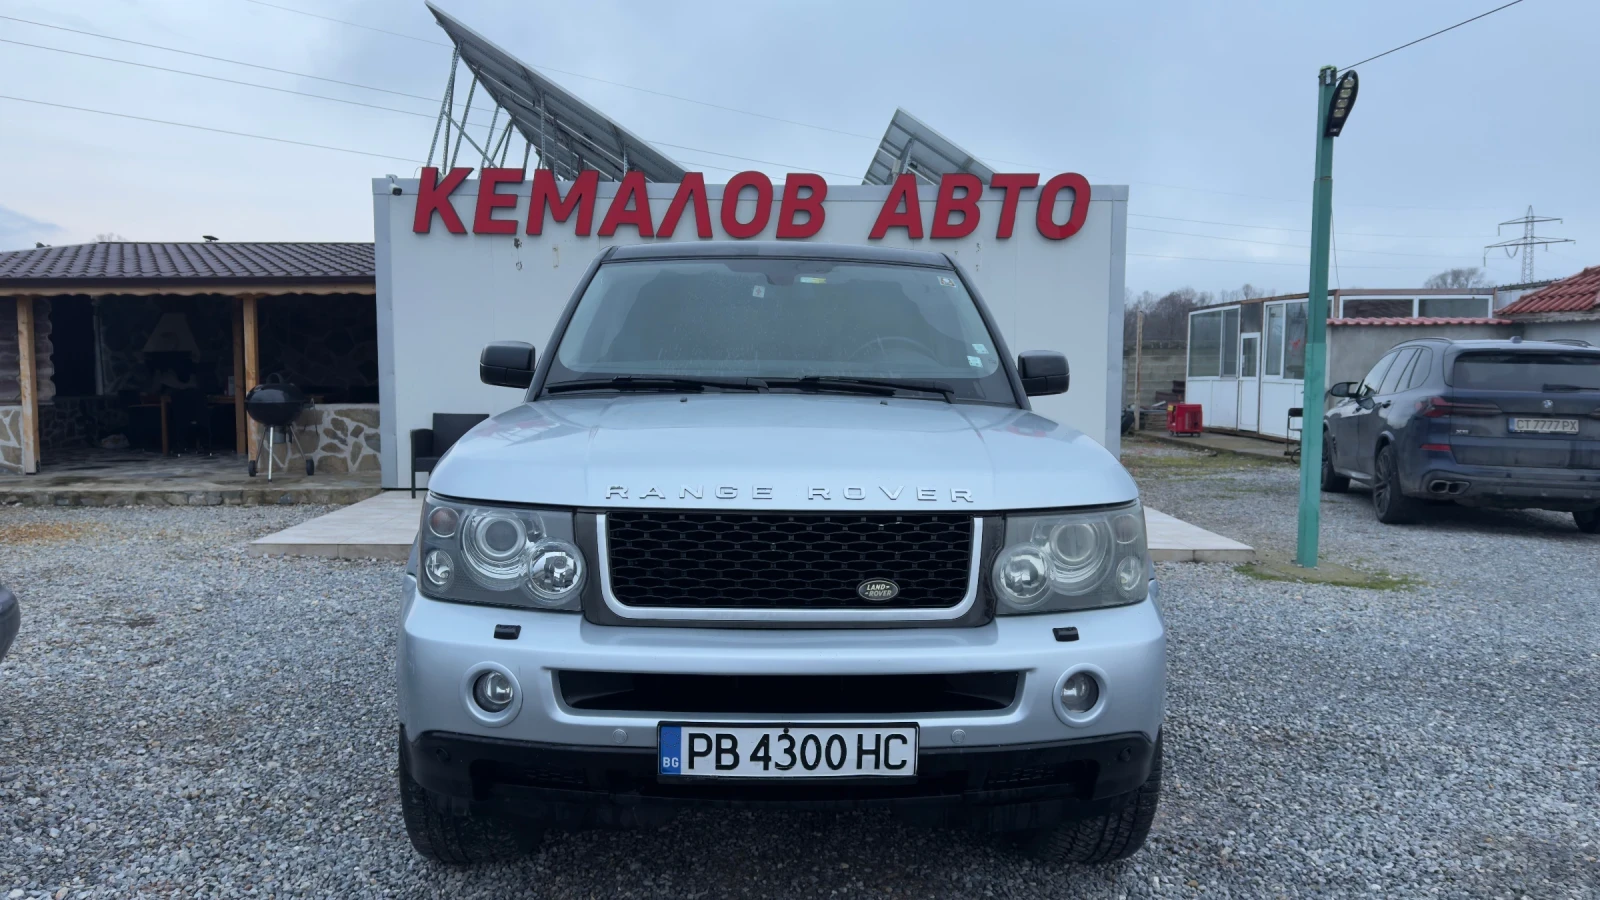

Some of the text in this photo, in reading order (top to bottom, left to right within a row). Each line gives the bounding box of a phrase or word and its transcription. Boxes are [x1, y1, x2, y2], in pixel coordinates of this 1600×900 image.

[413, 166, 1092, 240] КЕМАЛОВ АВТО
[1533, 420, 1560, 430] 7777
[605, 484, 975, 503] RANGE ROVER
[688, 733, 908, 771] PB 4300 HC
[662, 756, 680, 769] BG
